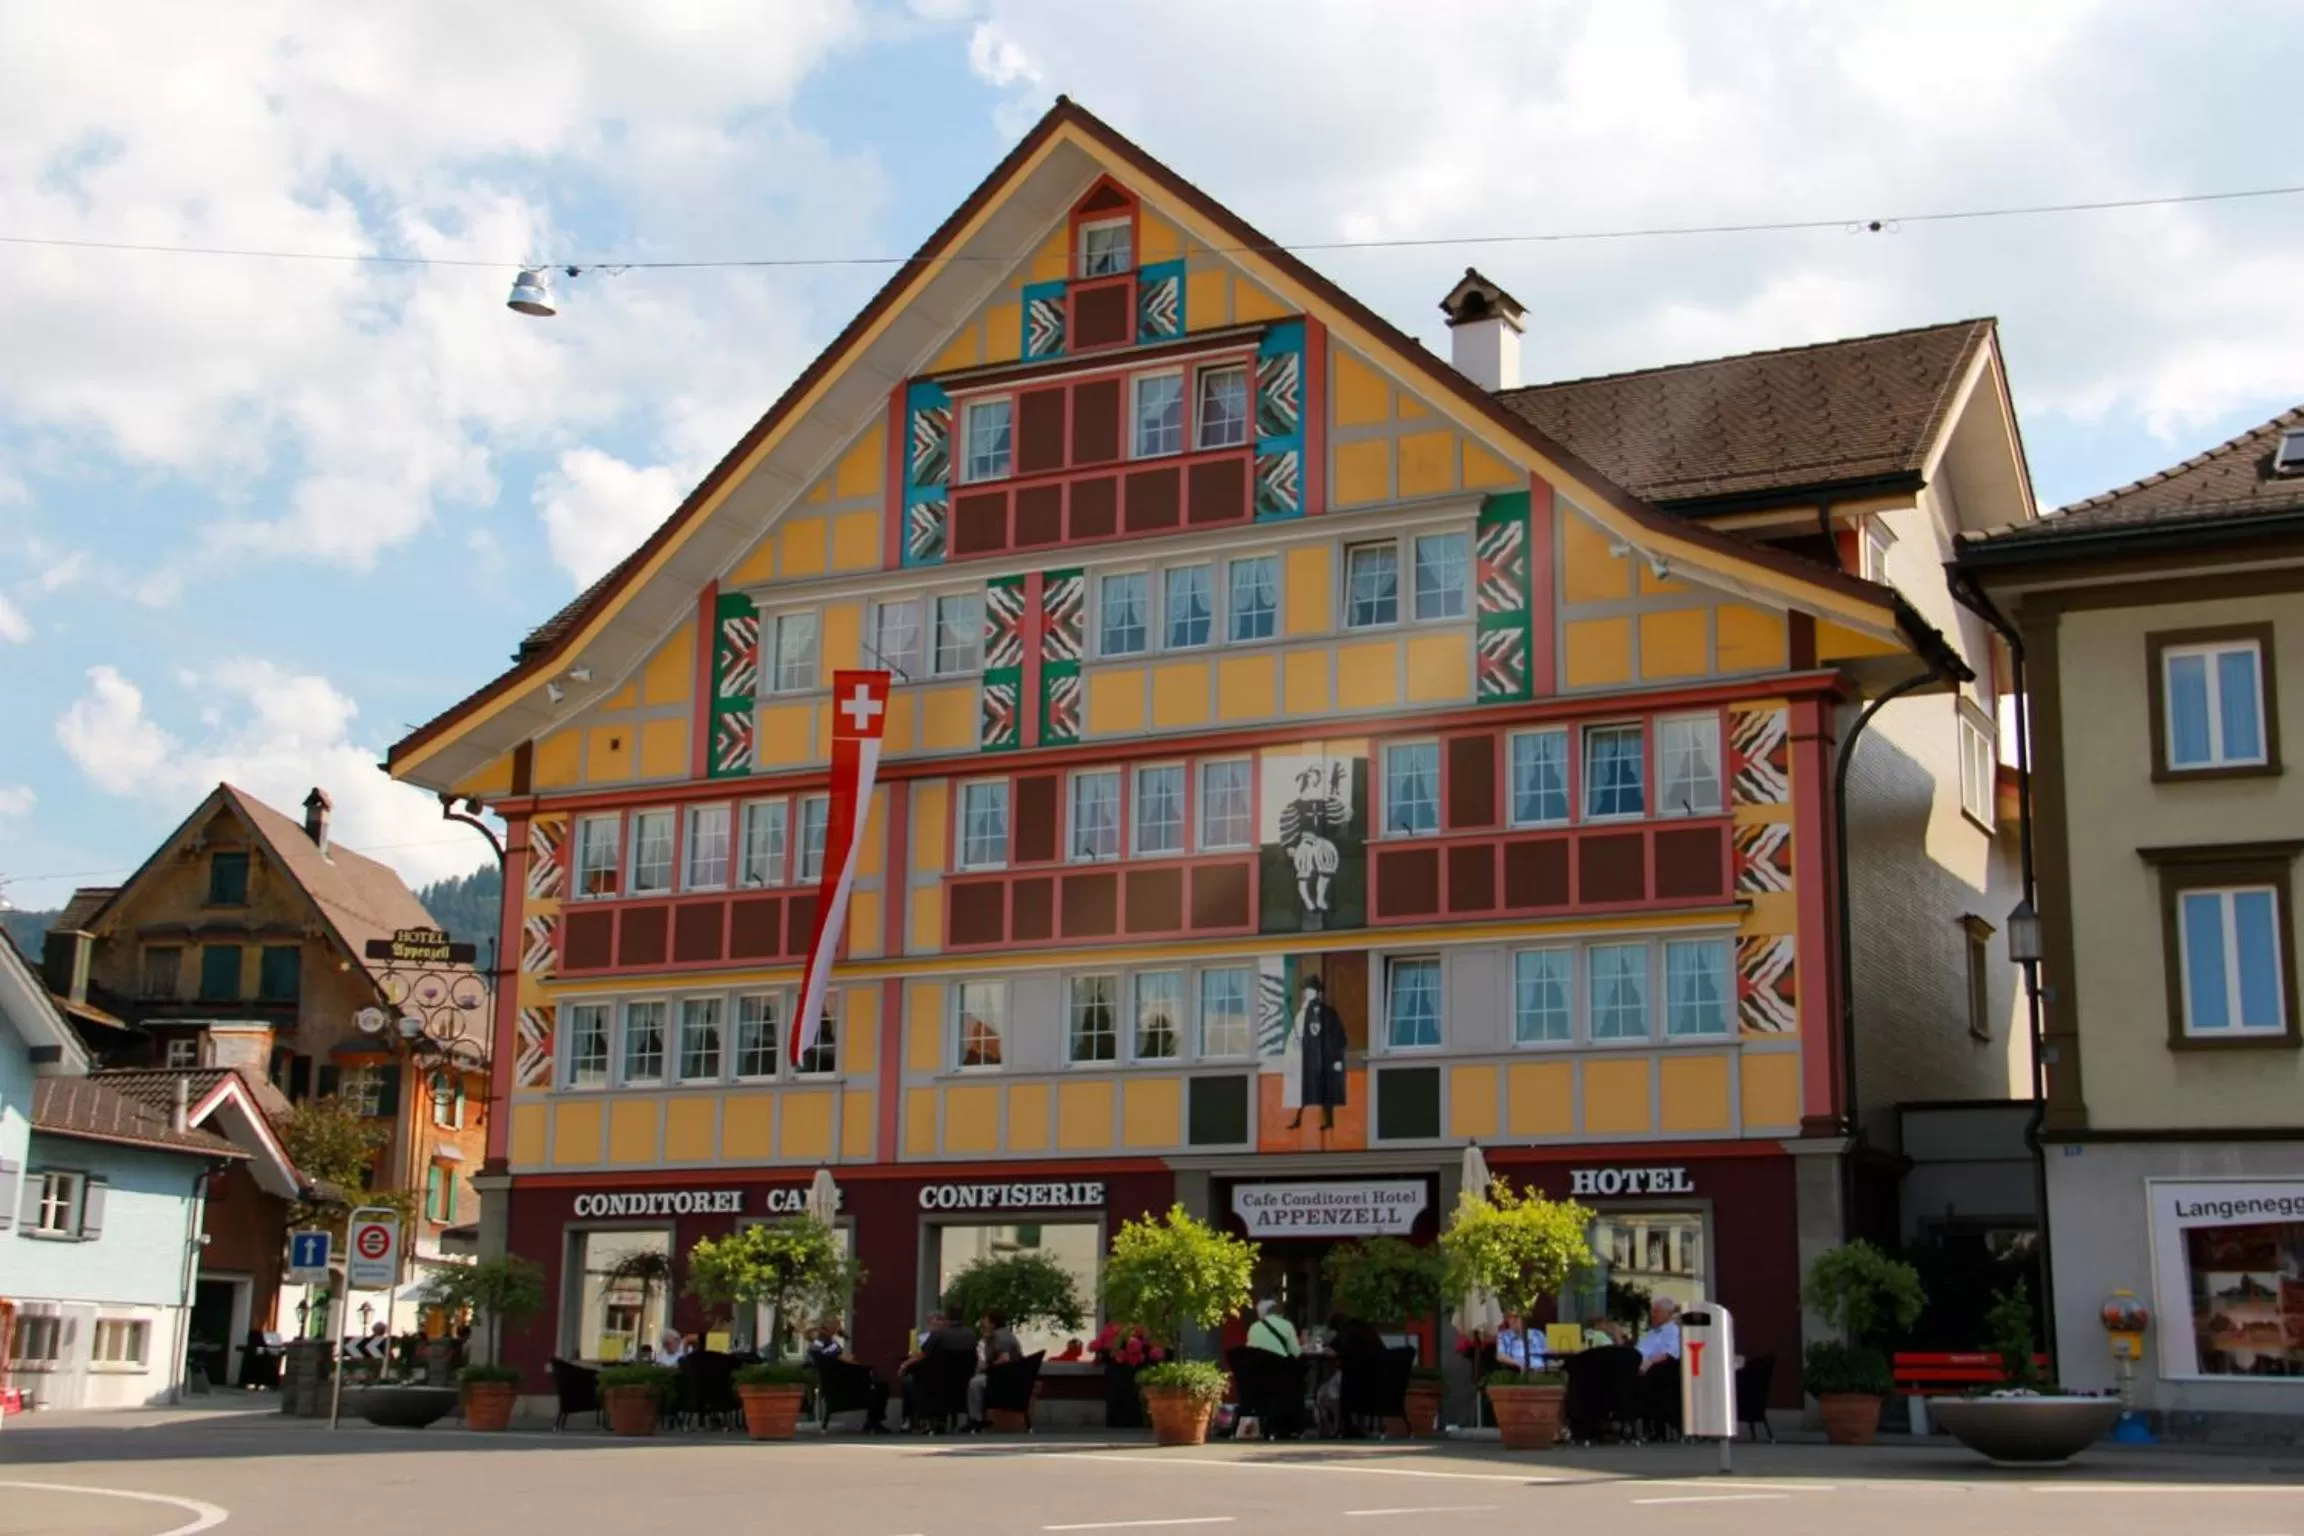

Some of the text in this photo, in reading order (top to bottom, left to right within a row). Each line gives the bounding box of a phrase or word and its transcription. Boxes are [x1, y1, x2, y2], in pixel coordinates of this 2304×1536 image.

[398, 930, 444, 944] HOTEL
[1570, 1167, 1695, 1195] HOTEL
[573, 1187, 843, 1216] CONDITOREI CA
[918, 1182, 1105, 1209] CONFISERIE
[1242, 1190, 1417, 1207] Cafe Conditorei Hotel
[1256, 1207, 1403, 1226] APPENZELL
